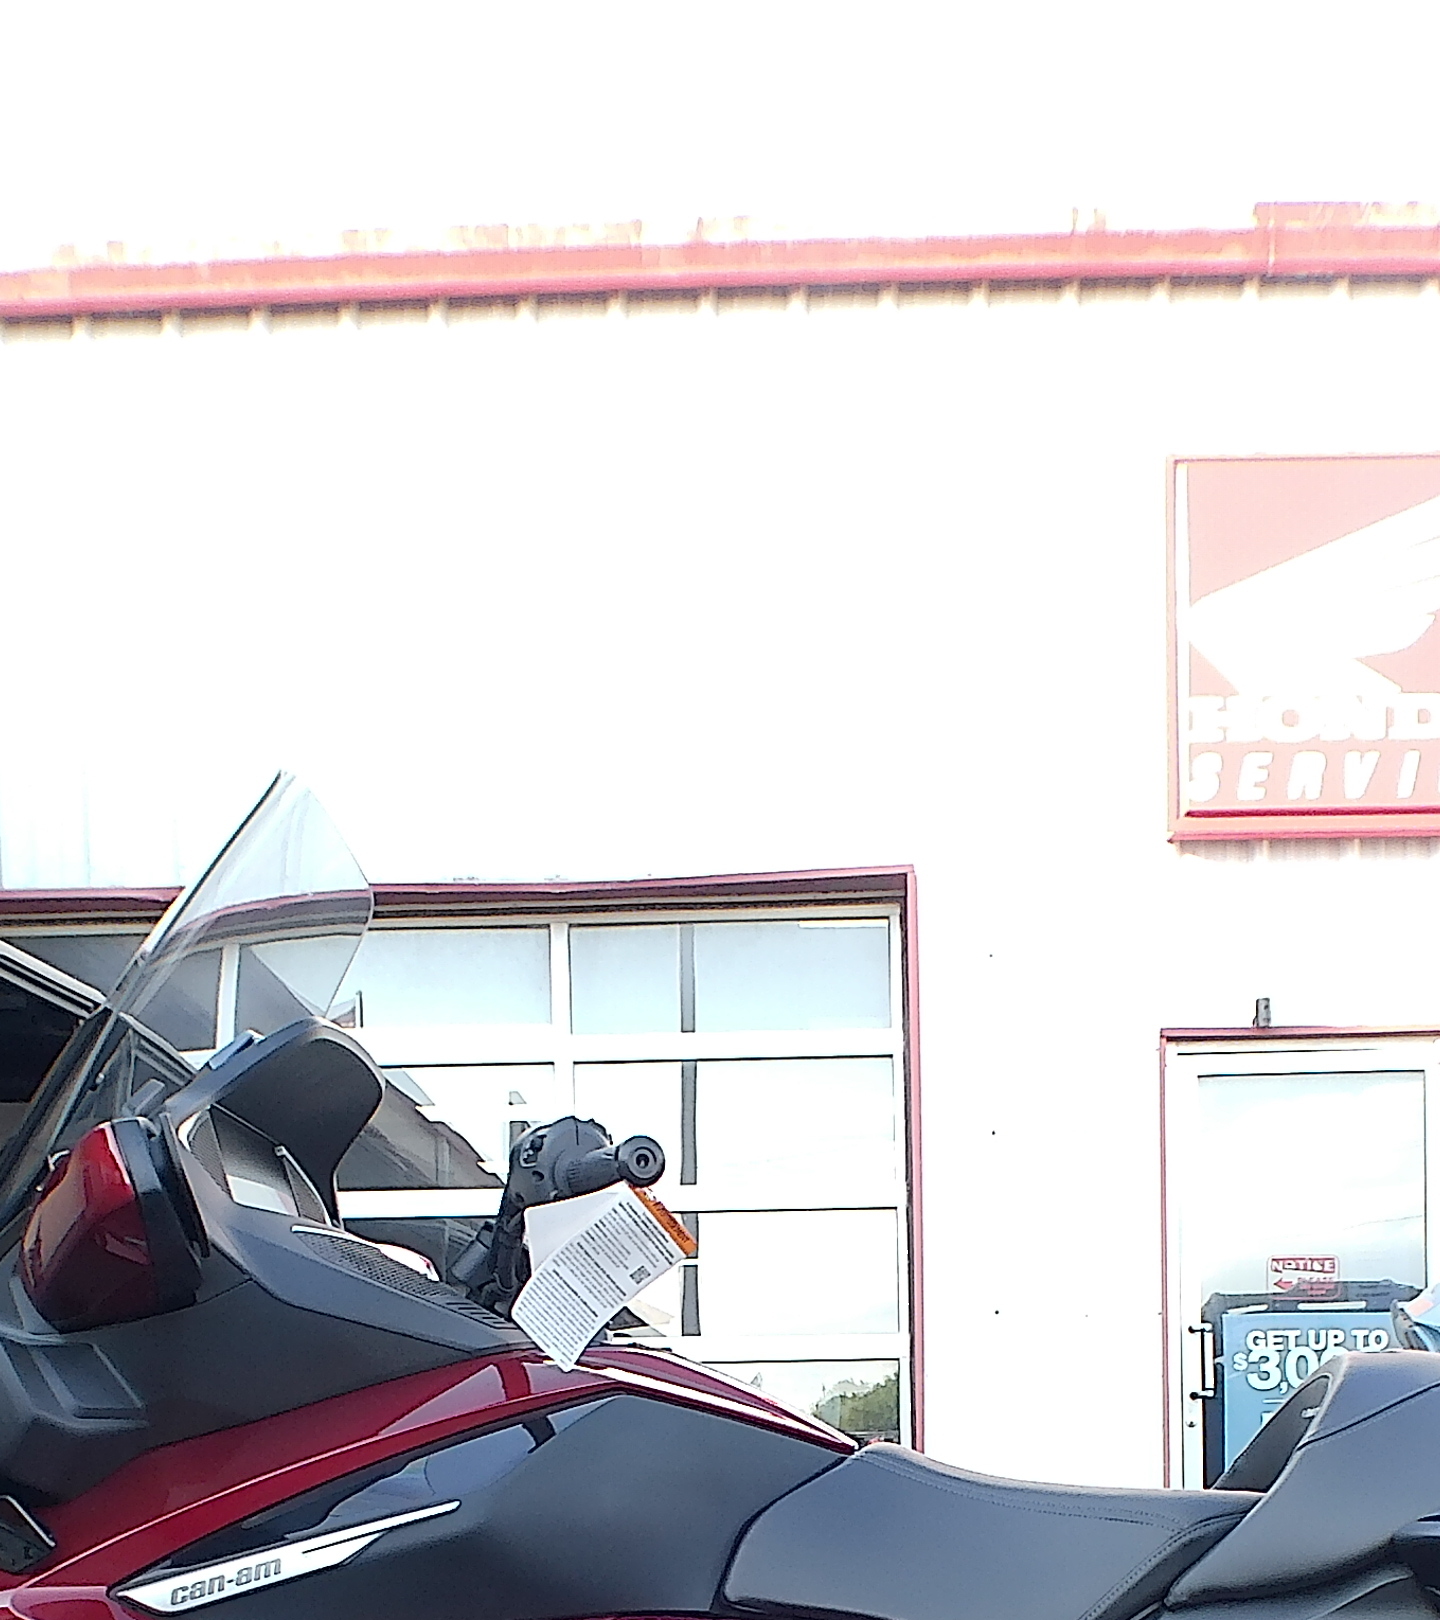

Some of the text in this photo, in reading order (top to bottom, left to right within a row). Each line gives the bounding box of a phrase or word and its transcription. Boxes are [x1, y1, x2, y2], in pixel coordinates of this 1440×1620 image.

[1271, 1258, 1335, 1273] NOTICE
[1246, 1329, 1389, 1351] GET UP TO
[1233, 1346, 1350, 1394] $3,0
[171, 1558, 281, 1605] can-am
